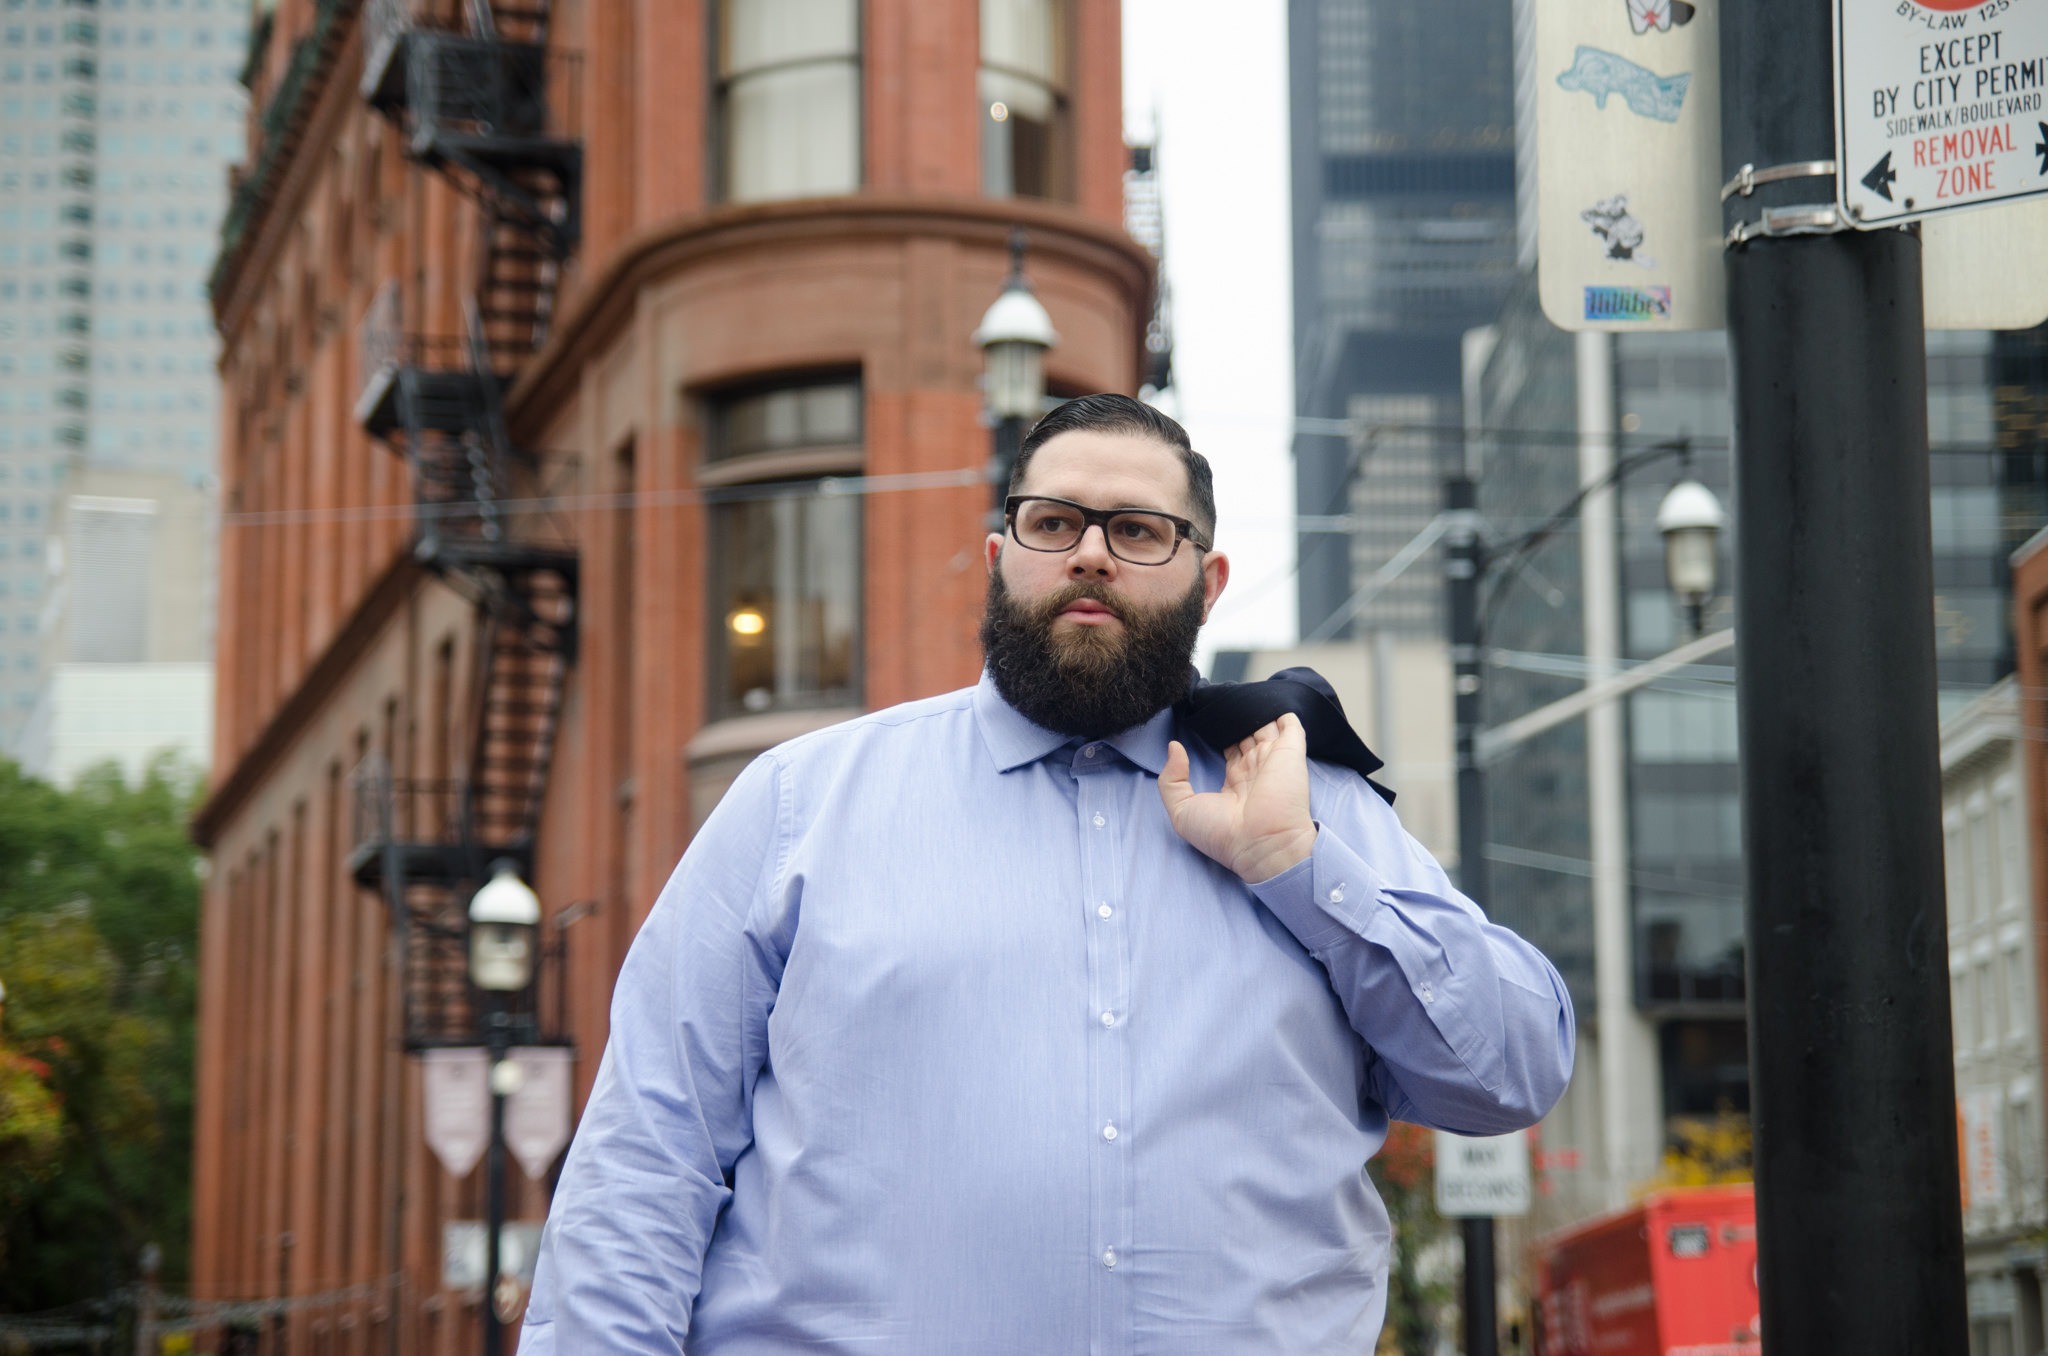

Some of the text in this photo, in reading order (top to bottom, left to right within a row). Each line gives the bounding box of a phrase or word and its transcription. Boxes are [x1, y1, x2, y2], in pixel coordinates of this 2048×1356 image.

[1896, 0, 2019, 30] BY-LAW 125
[1920, 31, 2002, 74] EXCEPT
[1873, 56, 2048, 119] BY CITY PERMI
[1886, 93, 2042, 139] SIDEWALK/BOULEVARD
[1913, 123, 2018, 168] REMOVAL
[1936, 160, 1996, 199] ZONE
